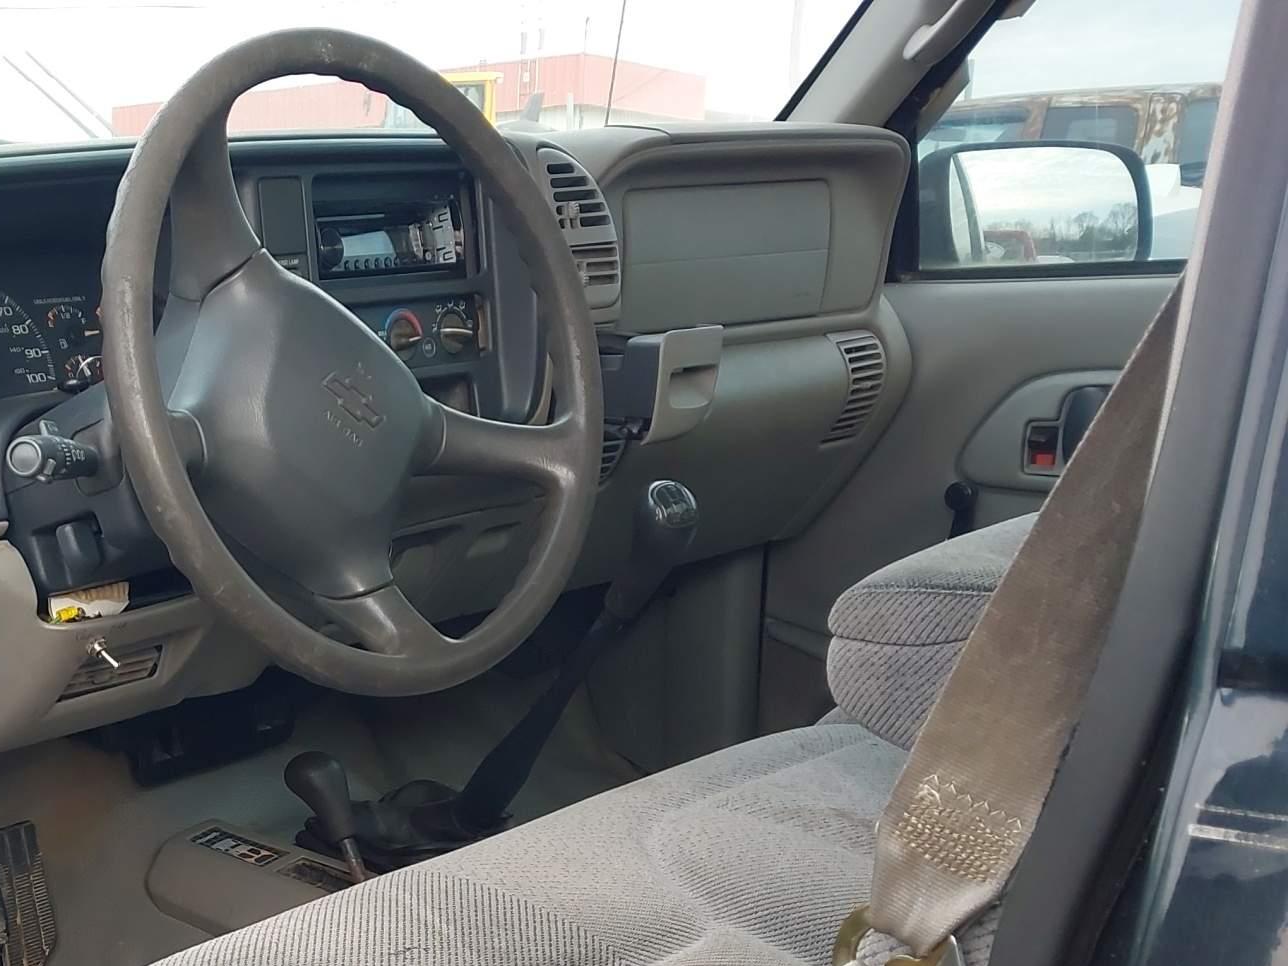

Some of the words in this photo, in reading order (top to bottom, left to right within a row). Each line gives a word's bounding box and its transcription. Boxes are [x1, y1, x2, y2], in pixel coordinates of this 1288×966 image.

[11, 324, 29, 335] 80
[24, 348, 42, 359] 90
[26, 372, 48, 384] 100
